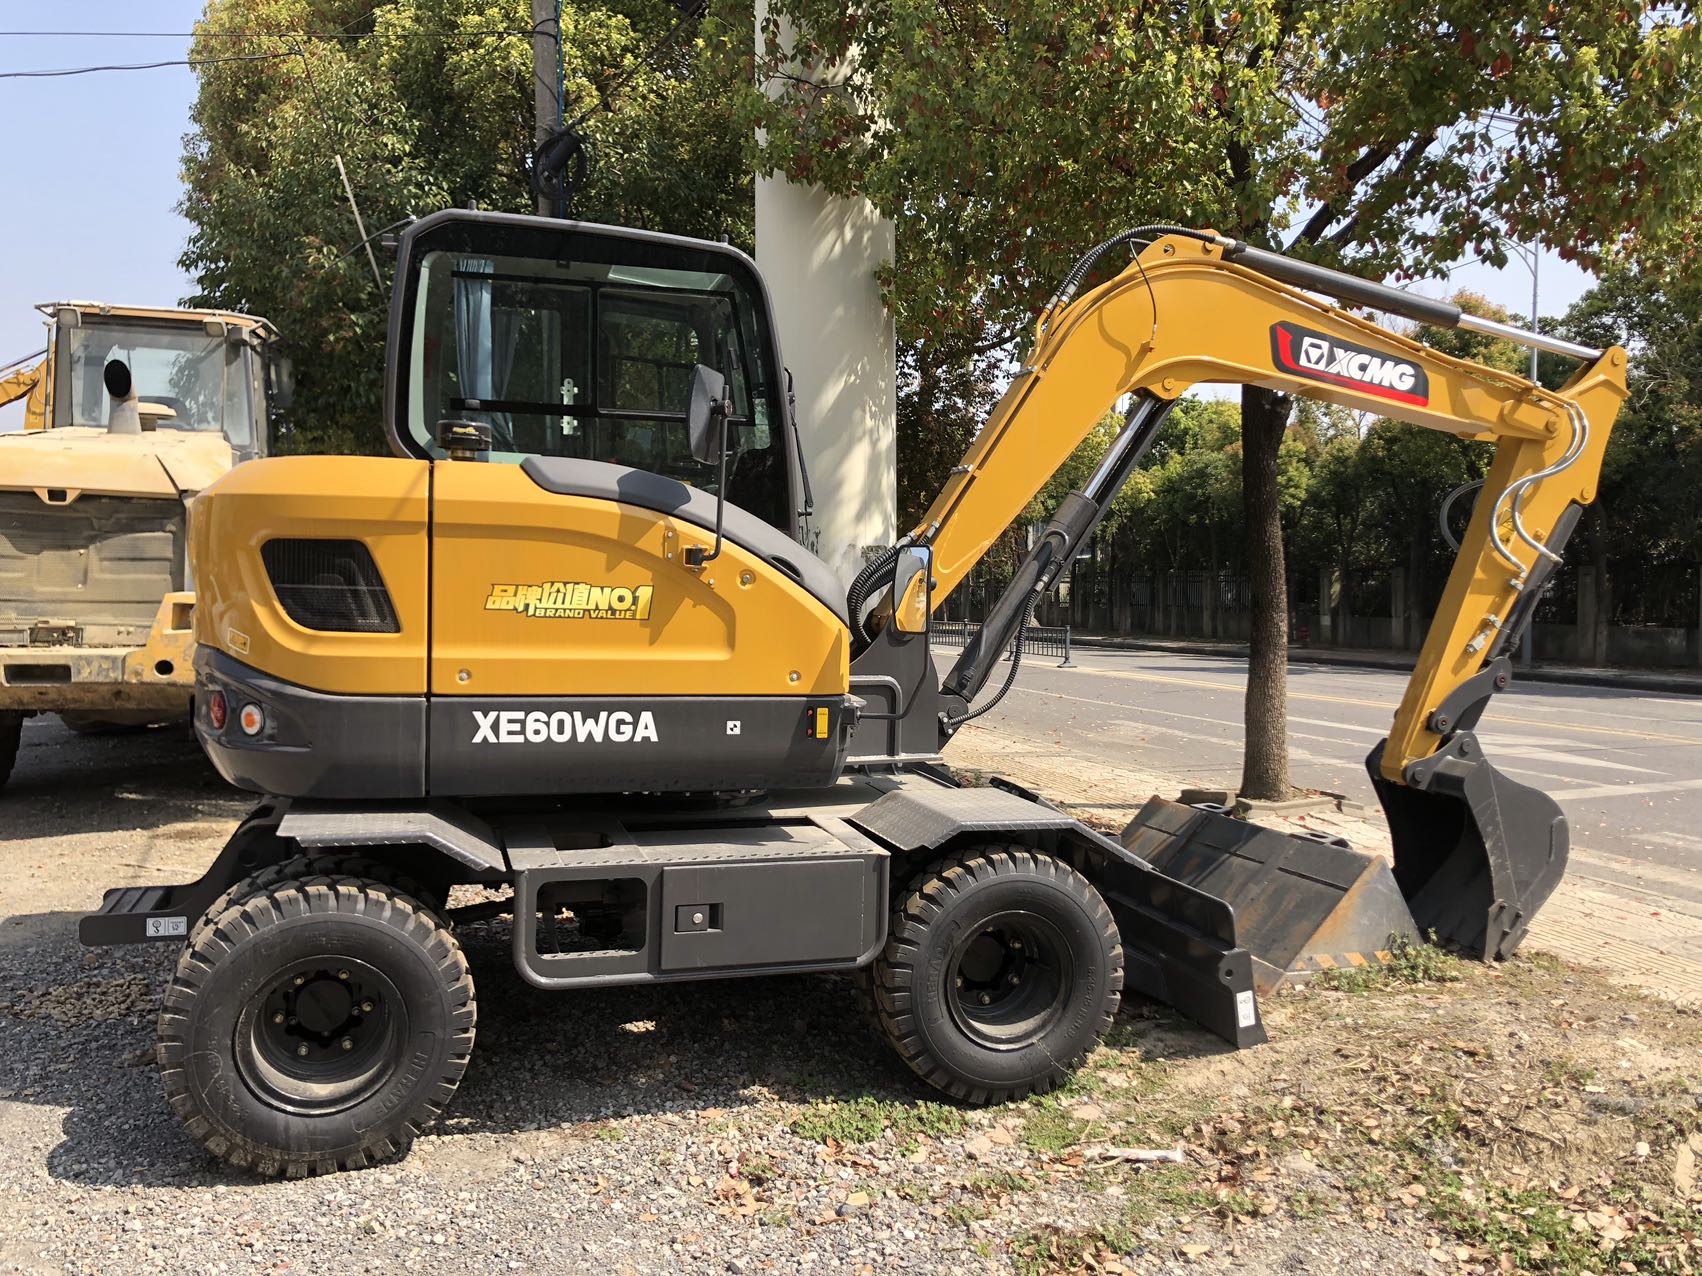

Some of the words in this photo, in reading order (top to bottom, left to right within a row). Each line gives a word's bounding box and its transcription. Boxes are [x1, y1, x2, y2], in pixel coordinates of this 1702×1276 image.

[1325, 346, 1415, 391] XCMG
[535, 608, 583, 618] BRAND
[590, 609, 634, 619] VALUE
[471, 711, 658, 743] XE60WGA
